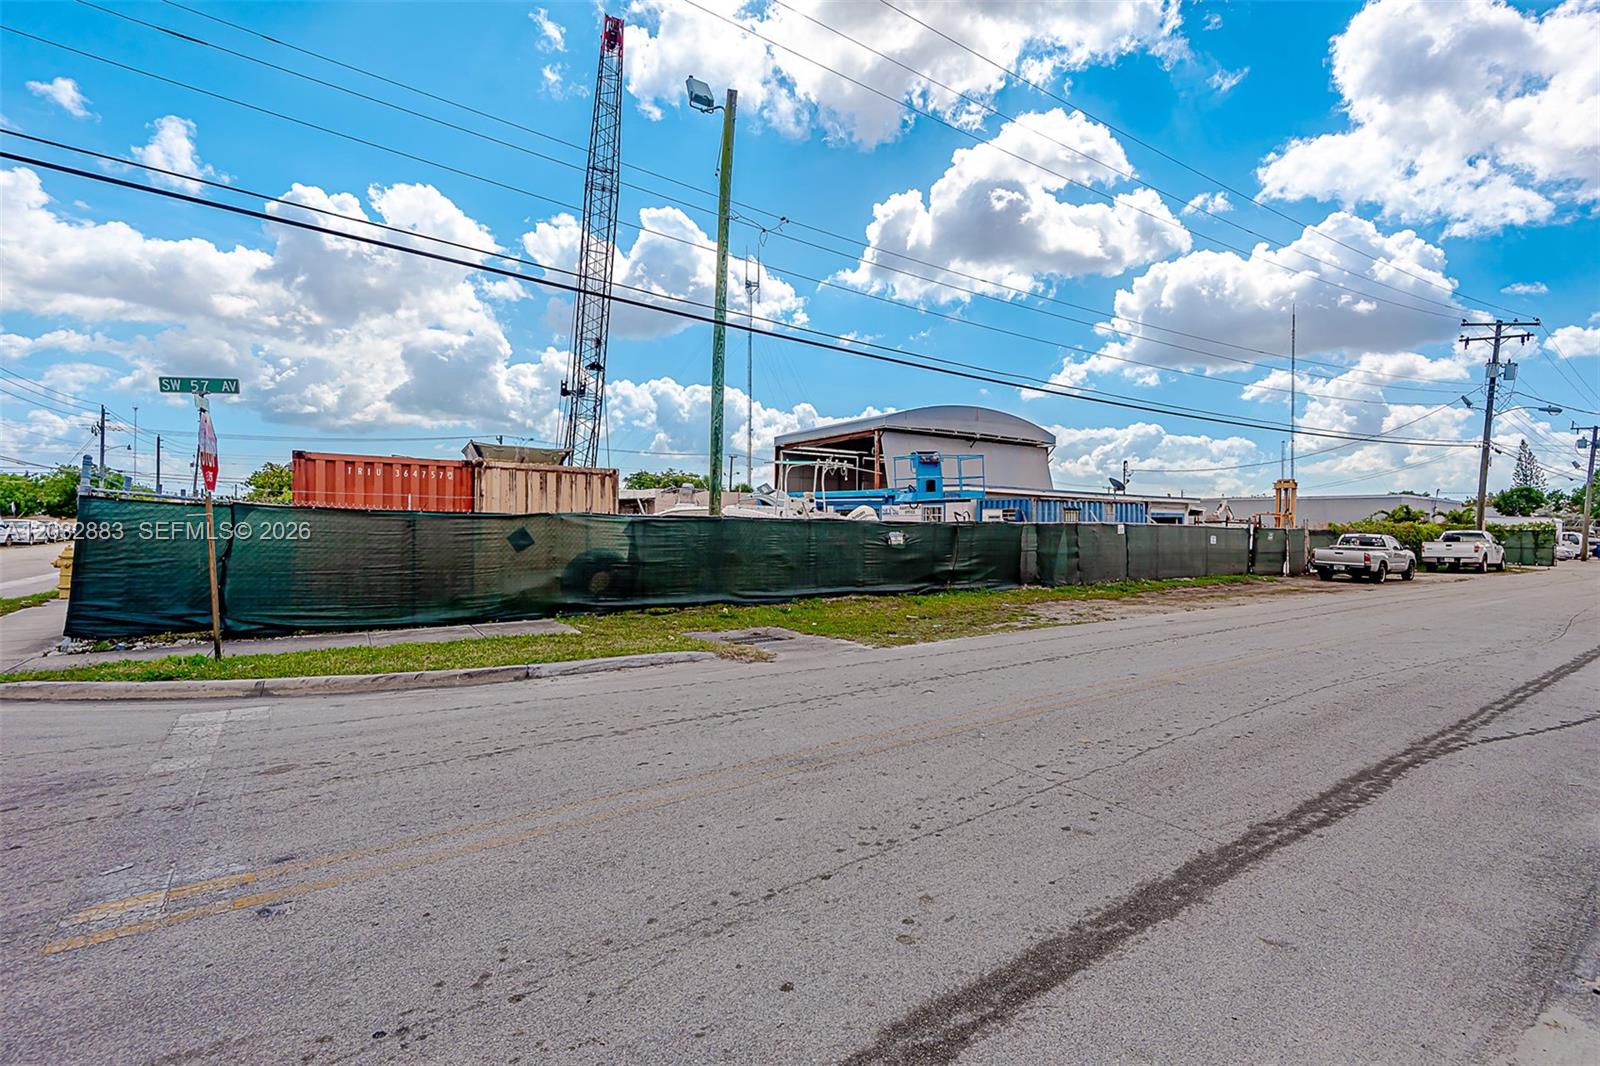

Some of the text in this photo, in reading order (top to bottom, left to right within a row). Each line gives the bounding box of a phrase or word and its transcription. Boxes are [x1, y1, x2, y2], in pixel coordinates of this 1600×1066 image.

[161, 379, 237, 392] SW 57 AV
[347, 466, 382, 476] TRIU
